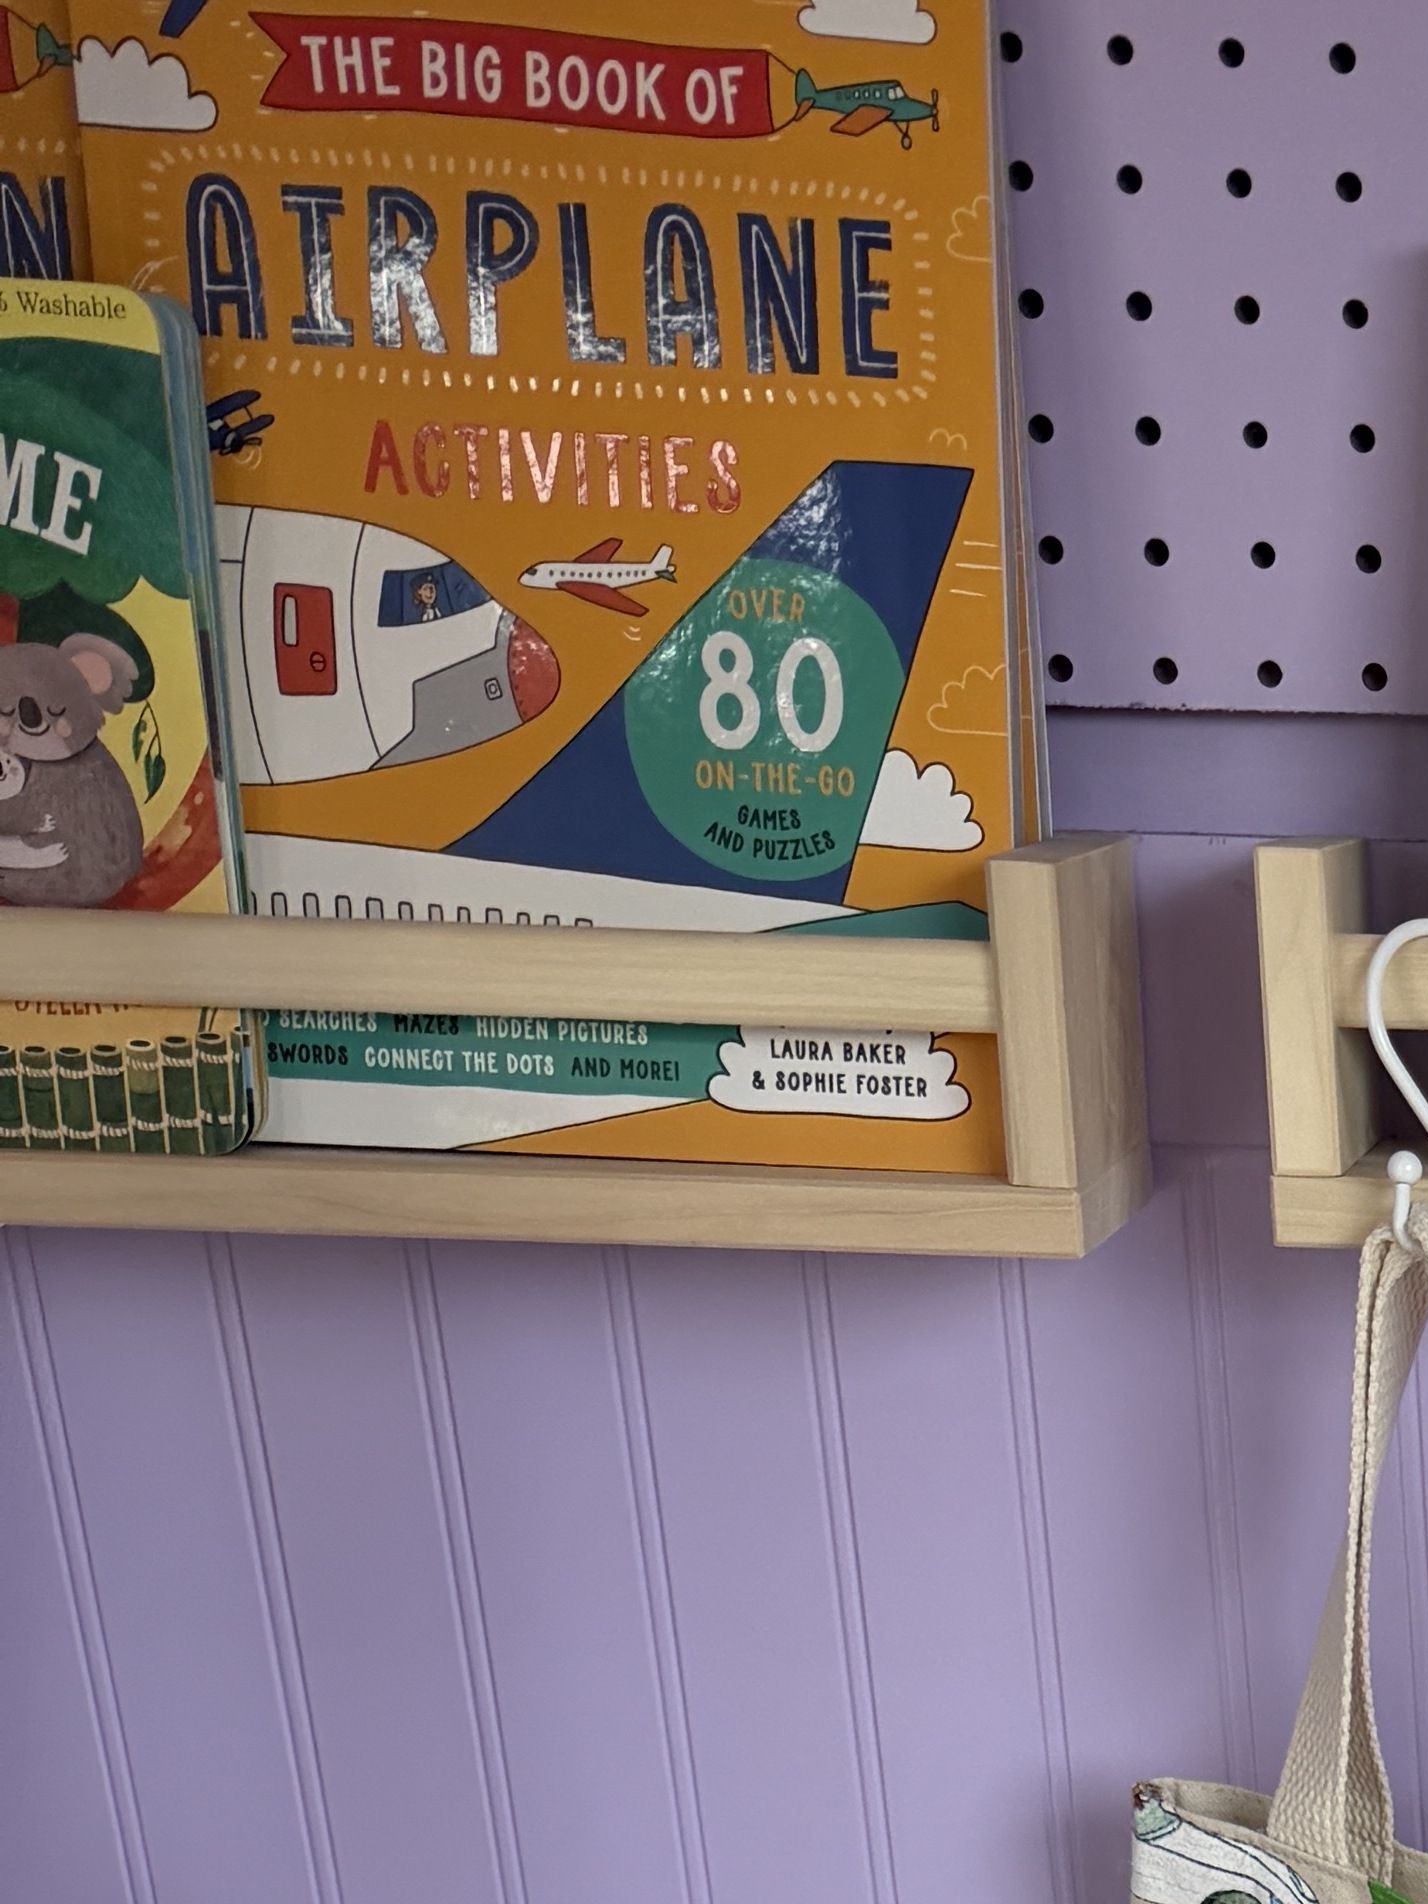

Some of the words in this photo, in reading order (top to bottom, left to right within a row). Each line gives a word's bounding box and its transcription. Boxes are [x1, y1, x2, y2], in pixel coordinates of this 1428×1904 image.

[300, 33, 402, 97] THE
[420, 42, 502, 103] BIG
[523, 51, 667, 123] BOOK
[685, 64, 745, 126] OF
[186, 172, 901, 379] AIRPLANE
[17, 291, 126, 320] Washable
[363, 418, 742, 515] ACTIVITIES
[728, 589, 806, 624] OVER
[699, 630, 844, 752] 80
[695, 760, 855, 797] ON-THE-GO
[737, 805, 801, 831] GAMES
[704, 822, 744, 853] AND
[753, 831, 836, 861] PUZZLES
[365, 1047, 454, 1074] CONNECT
[462, 1051, 500, 1075] THE
[506, 1052, 555, 1077] DOTS
[570, 1058, 611, 1081] AND
[769, 1038, 834, 1062] LAURA
[842, 1040, 907, 1066] BAKER
[773, 1073, 849, 1096] SOPHIE
[855, 1075, 928, 1099] FOSTER
